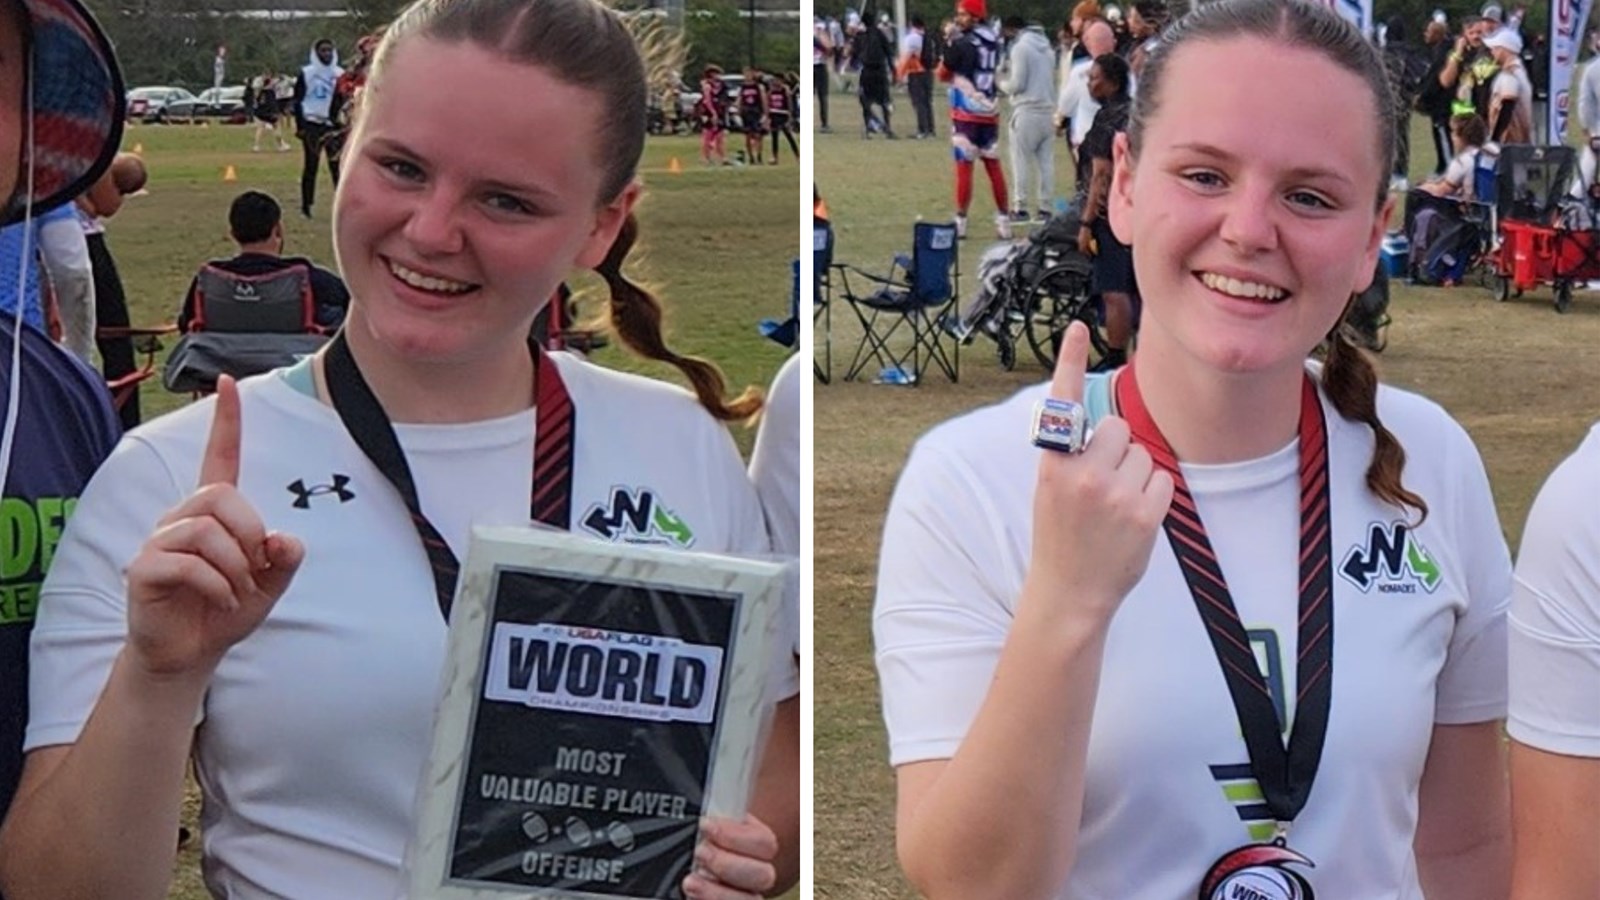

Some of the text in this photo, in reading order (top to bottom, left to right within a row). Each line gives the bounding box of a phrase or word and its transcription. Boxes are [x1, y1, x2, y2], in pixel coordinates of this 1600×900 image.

[0, 497, 78, 578] DE
[508, 636, 706, 709] WORLD
[556, 746, 626, 777] MOST
[480, 773, 687, 820] VALUABLE PLAYER
[521, 851, 624, 883] OFFENSE
